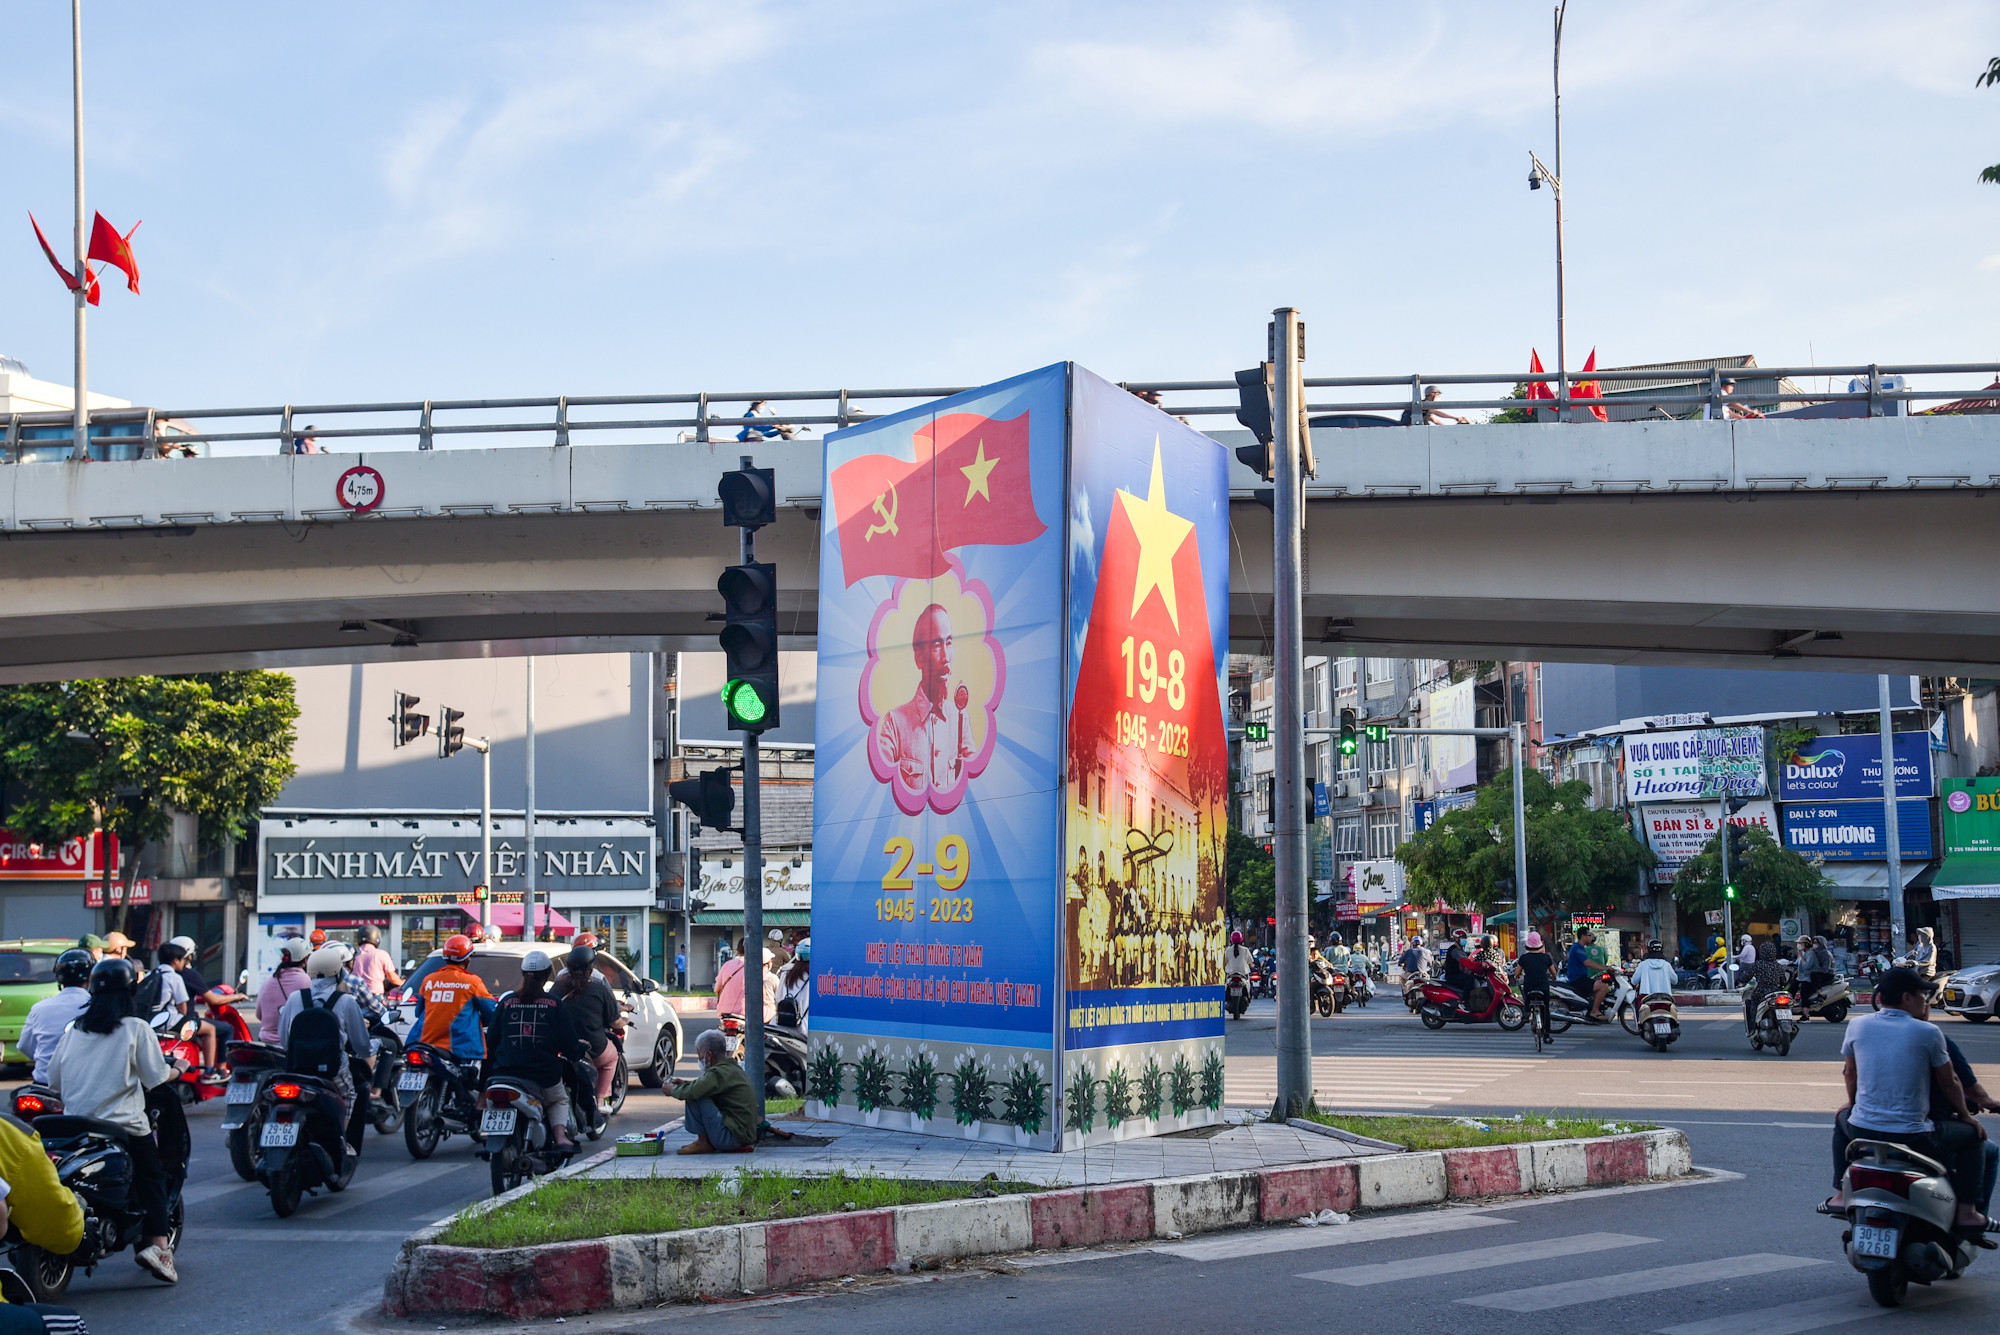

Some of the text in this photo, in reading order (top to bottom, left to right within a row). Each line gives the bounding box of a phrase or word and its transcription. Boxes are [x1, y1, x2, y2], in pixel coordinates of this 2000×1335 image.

[348, 480, 373, 498] 4,75m
[1122, 635, 1185, 711] 19-8
[1116, 710, 1147, 750] 1945
[1158, 720, 1189, 758] 2023
[1247, 726, 1266, 739] 41
[1366, 725, 1387, 741] 41
[1630, 742, 1650, 766] VỰA
[1652, 741, 1680, 761] CUNG
[1683, 733, 1702, 759] CẤP
[1633, 765, 1653, 778] SỐ
[1659, 768, 1666, 777] 1
[1672, 766, 1697, 777] TẠI
[1787, 764, 1838, 780] Dulux
[1862, 767, 1882, 777] THU
[1635, 776, 1758, 796] Hương Dừa
[1787, 781, 1839, 790] let's colour
[1789, 807, 1838, 820] ĐẠI LÝ SƠN
[1653, 817, 1682, 832] BÁN
[1685, 814, 1700, 831] SỈ
[1704, 818, 1714, 830] &
[1789, 825, 1877, 845] THU HƯƠNG
[272, 839, 369, 881] KÍNH
[372, 834, 449, 880] MẮT
[543, 843, 646, 877] NHÃN
[882, 834, 970, 891] 2-9
[876, 898, 914, 922] 1945
[930, 898, 973, 923] 2023
[351, 918, 387, 926] PRADA
[866, 938, 983, 969] NHIỆT LIỆT CHÀO MỪNG 78 NĂM
[433, 980, 470, 990] Ahamove
[817, 967, 1041, 1011] QUỐC KHÁNH NƯỚC CỘNG HÒA XÃ HỘI CHỦ NGHĨA VIỆT NAM !
[1085, 1003, 1096, 1032] LIỆT
[486, 1121, 509, 1130] 4207
[264, 1135, 295, 1146] 100.50
[1859, 1227, 1891, 1242] 30-L6
